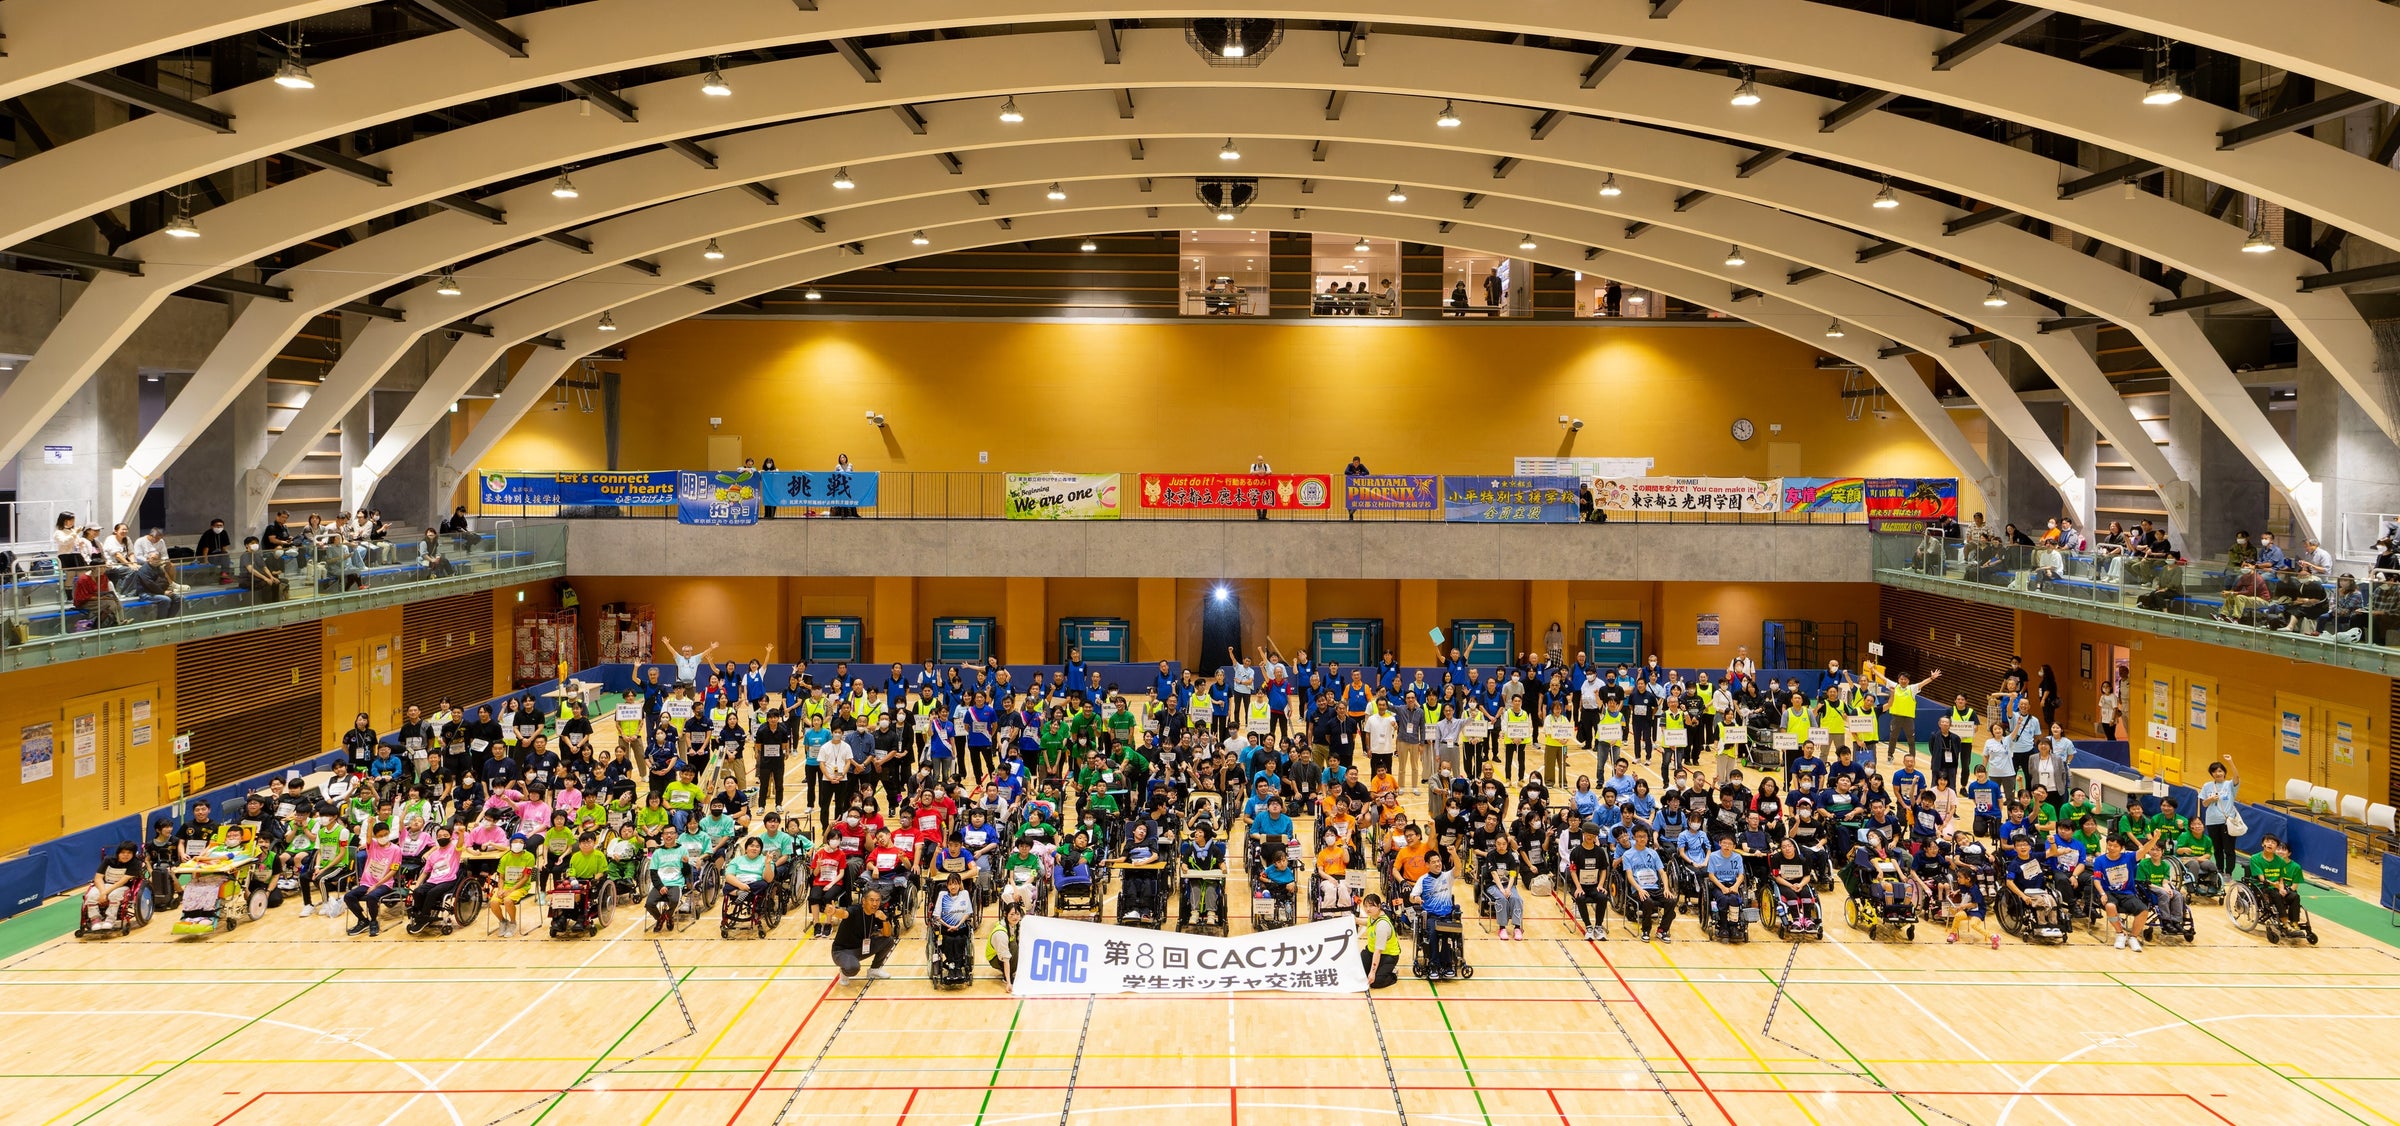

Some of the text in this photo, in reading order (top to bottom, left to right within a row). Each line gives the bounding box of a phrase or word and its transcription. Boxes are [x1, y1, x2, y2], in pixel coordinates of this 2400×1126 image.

[555, 473, 649, 484] Let's connect
[1168, 477, 1188, 487] Just
[1189, 477, 1201, 486] do
[1202, 476, 1215, 486] it!
[1353, 478, 1408, 487] MURAYAMA
[601, 483, 674, 494] our hearts
[787, 474, 852, 499] 挑戦
[1021, 486, 1050, 497] Beginning
[1692, 485, 1707, 493] You
[614, 494, 674, 503] 心をつなげよう
[1347, 486, 1416, 501] PHOENIX
[1448, 489, 1576, 505] 小平特別支援学校
[1784, 487, 1862, 504] 友情 笑顔
[1013, 487, 1093, 513] We are one
[1646, 853, 1652, 863] 2
[1730, 860, 1739, 870] 12
[1030, 938, 1089, 983] CAC
[1122, 968, 1339, 989] 学生ボッチャ交流戦
